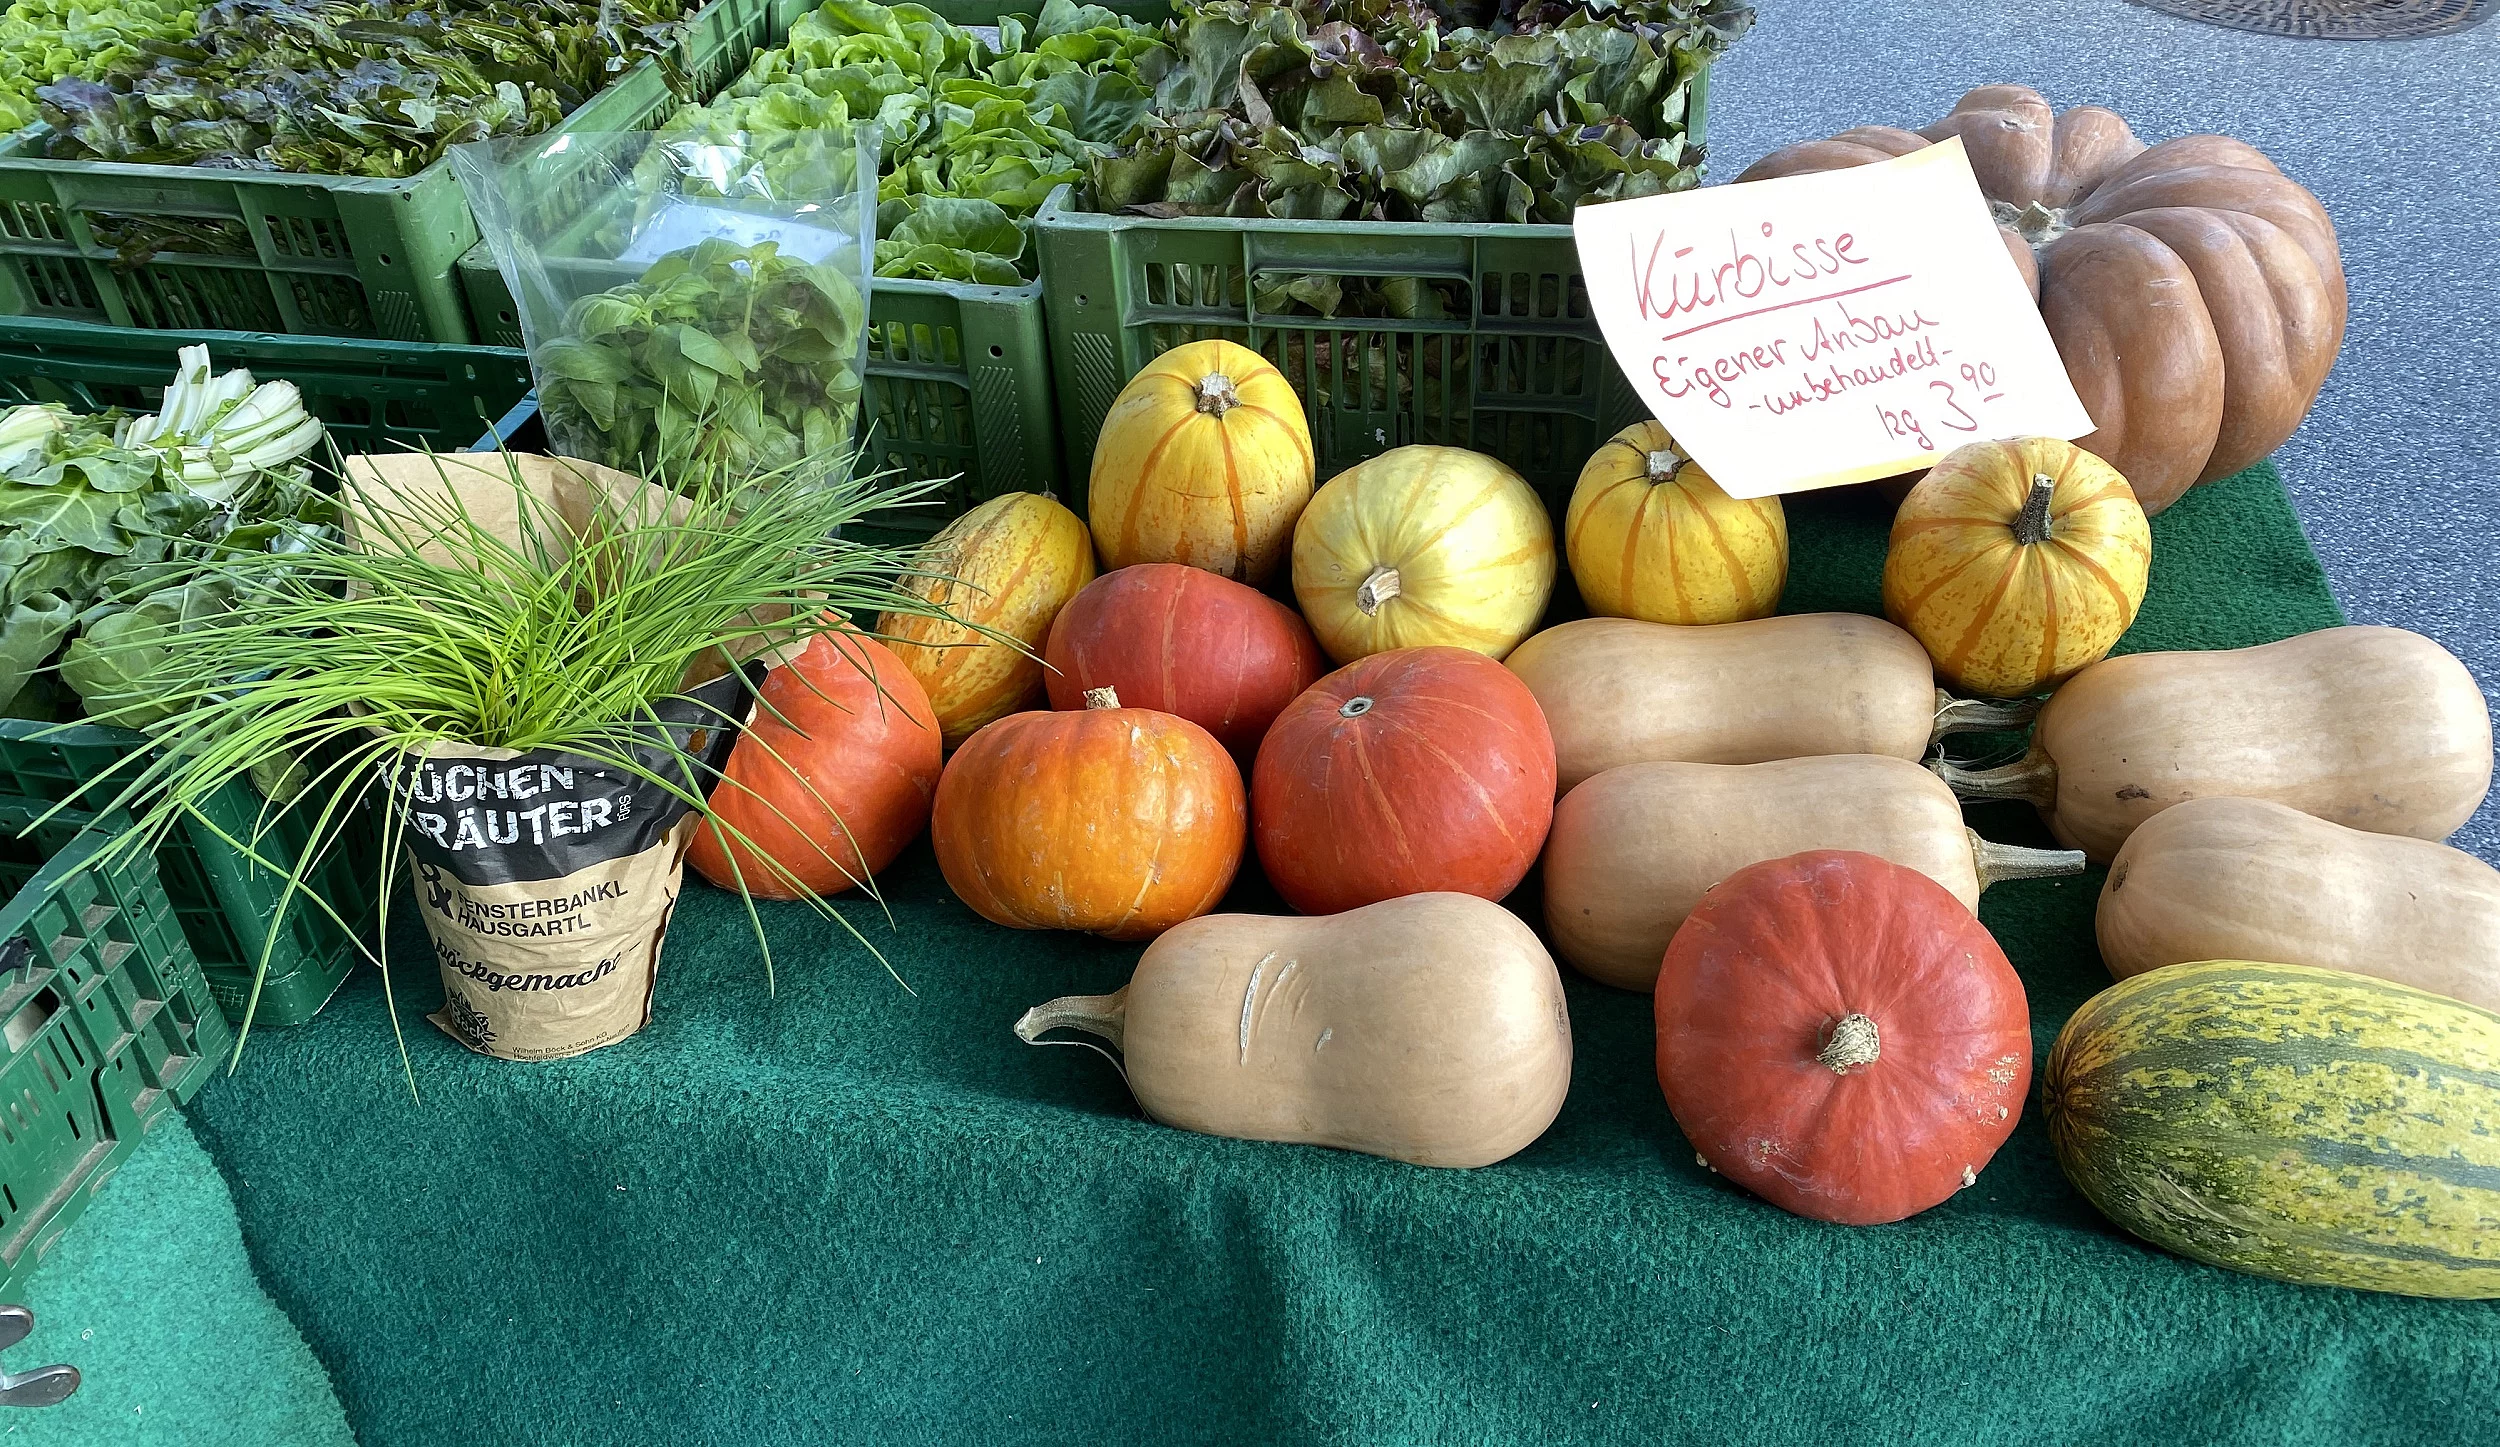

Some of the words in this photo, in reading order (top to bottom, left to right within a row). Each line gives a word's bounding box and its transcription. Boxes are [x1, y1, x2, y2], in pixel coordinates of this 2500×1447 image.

[1629, 221, 1869, 321] Kürbisse
[1652, 338, 1787, 409] Eigener
[1800, 300, 1940, 362] Anbau
[1875, 403, 1935, 451] kg
[616, 794, 632, 822] FÜRS
[456, 879, 629, 920] FENSTERBANKL
[457, 906, 592, 938] HAUSGARTL
[512, 1046, 543, 1054] Wilhelm
[575, 1037, 595, 1048] Sohn
